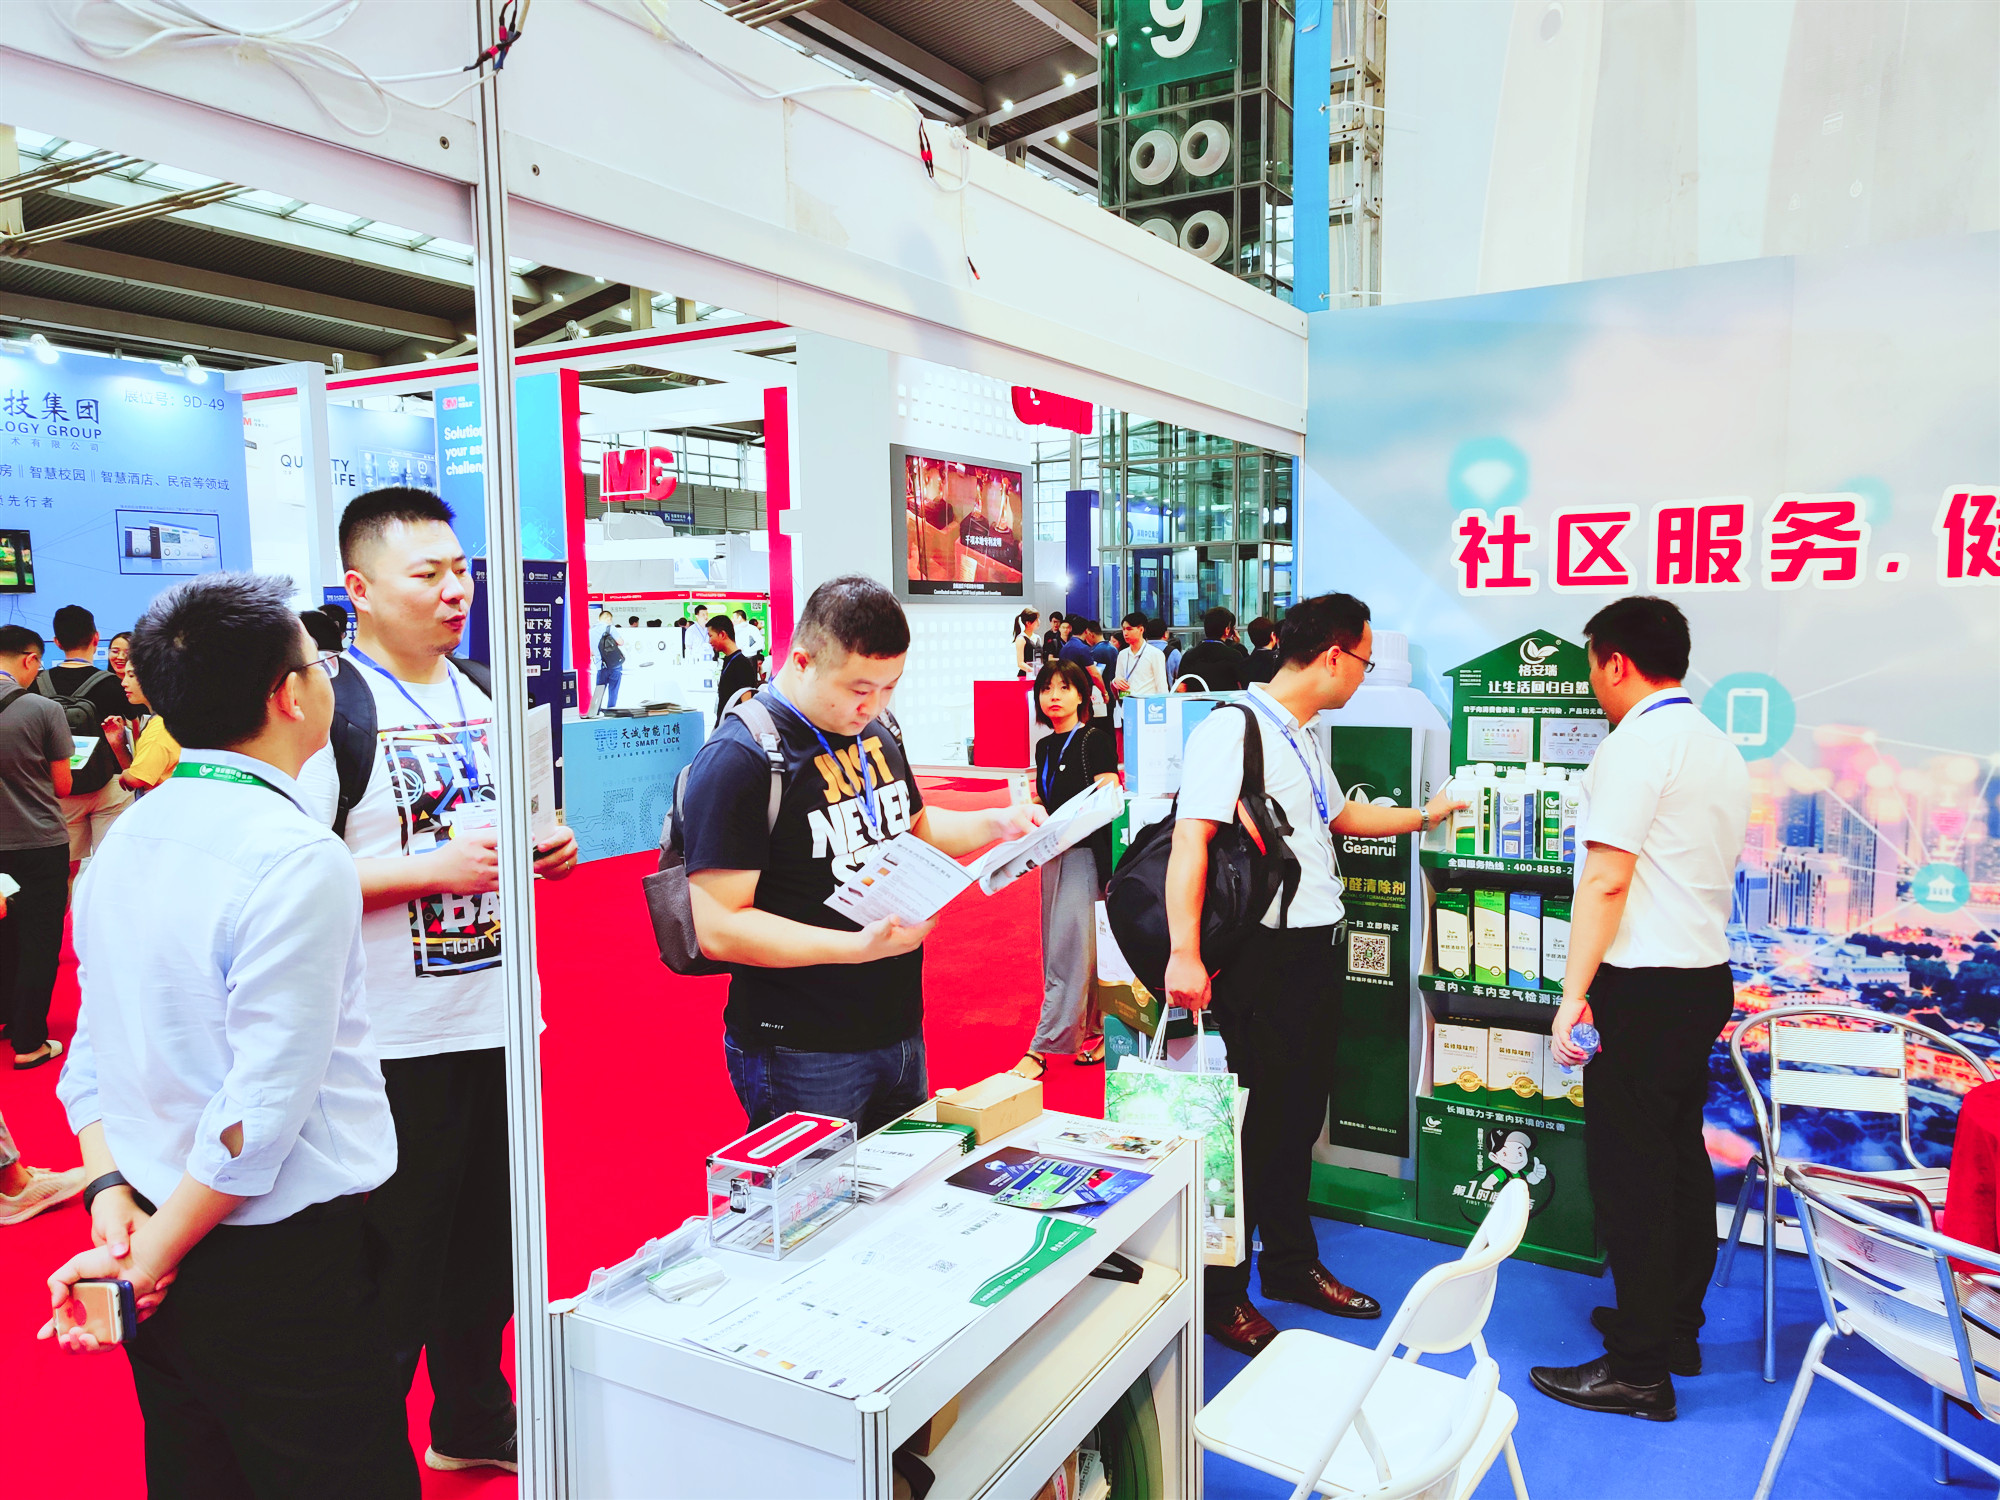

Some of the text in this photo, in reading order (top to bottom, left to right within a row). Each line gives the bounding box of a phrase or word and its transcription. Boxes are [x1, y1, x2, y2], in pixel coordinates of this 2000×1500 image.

[1150, 0, 1202, 59] 9
[2, 388, 100, 425] 技集团
[46, 424, 102, 440] GROUP
[445, 447, 468, 462] your
[29, 465, 87, 482] 智慧校园
[100, 470, 230, 491] 智慧酒店、民宿等领域
[331, 473, 357, 487] IFE
[1518, 664, 1558, 677] 格安瑞
[1488, 681, 1590, 695] 让生活回归自然
[635, 739, 659, 748] SMART
[663, 736, 680, 745] LOCK
[813, 736, 894, 803] JUST
[1342, 840, 1397, 857] Geanrui
[1366, 921, 1400, 932] 立即购买
[443, 934, 486, 955] FIGHT
[1446, 1104, 1566, 1132] 长期致力于室内环境的改善
